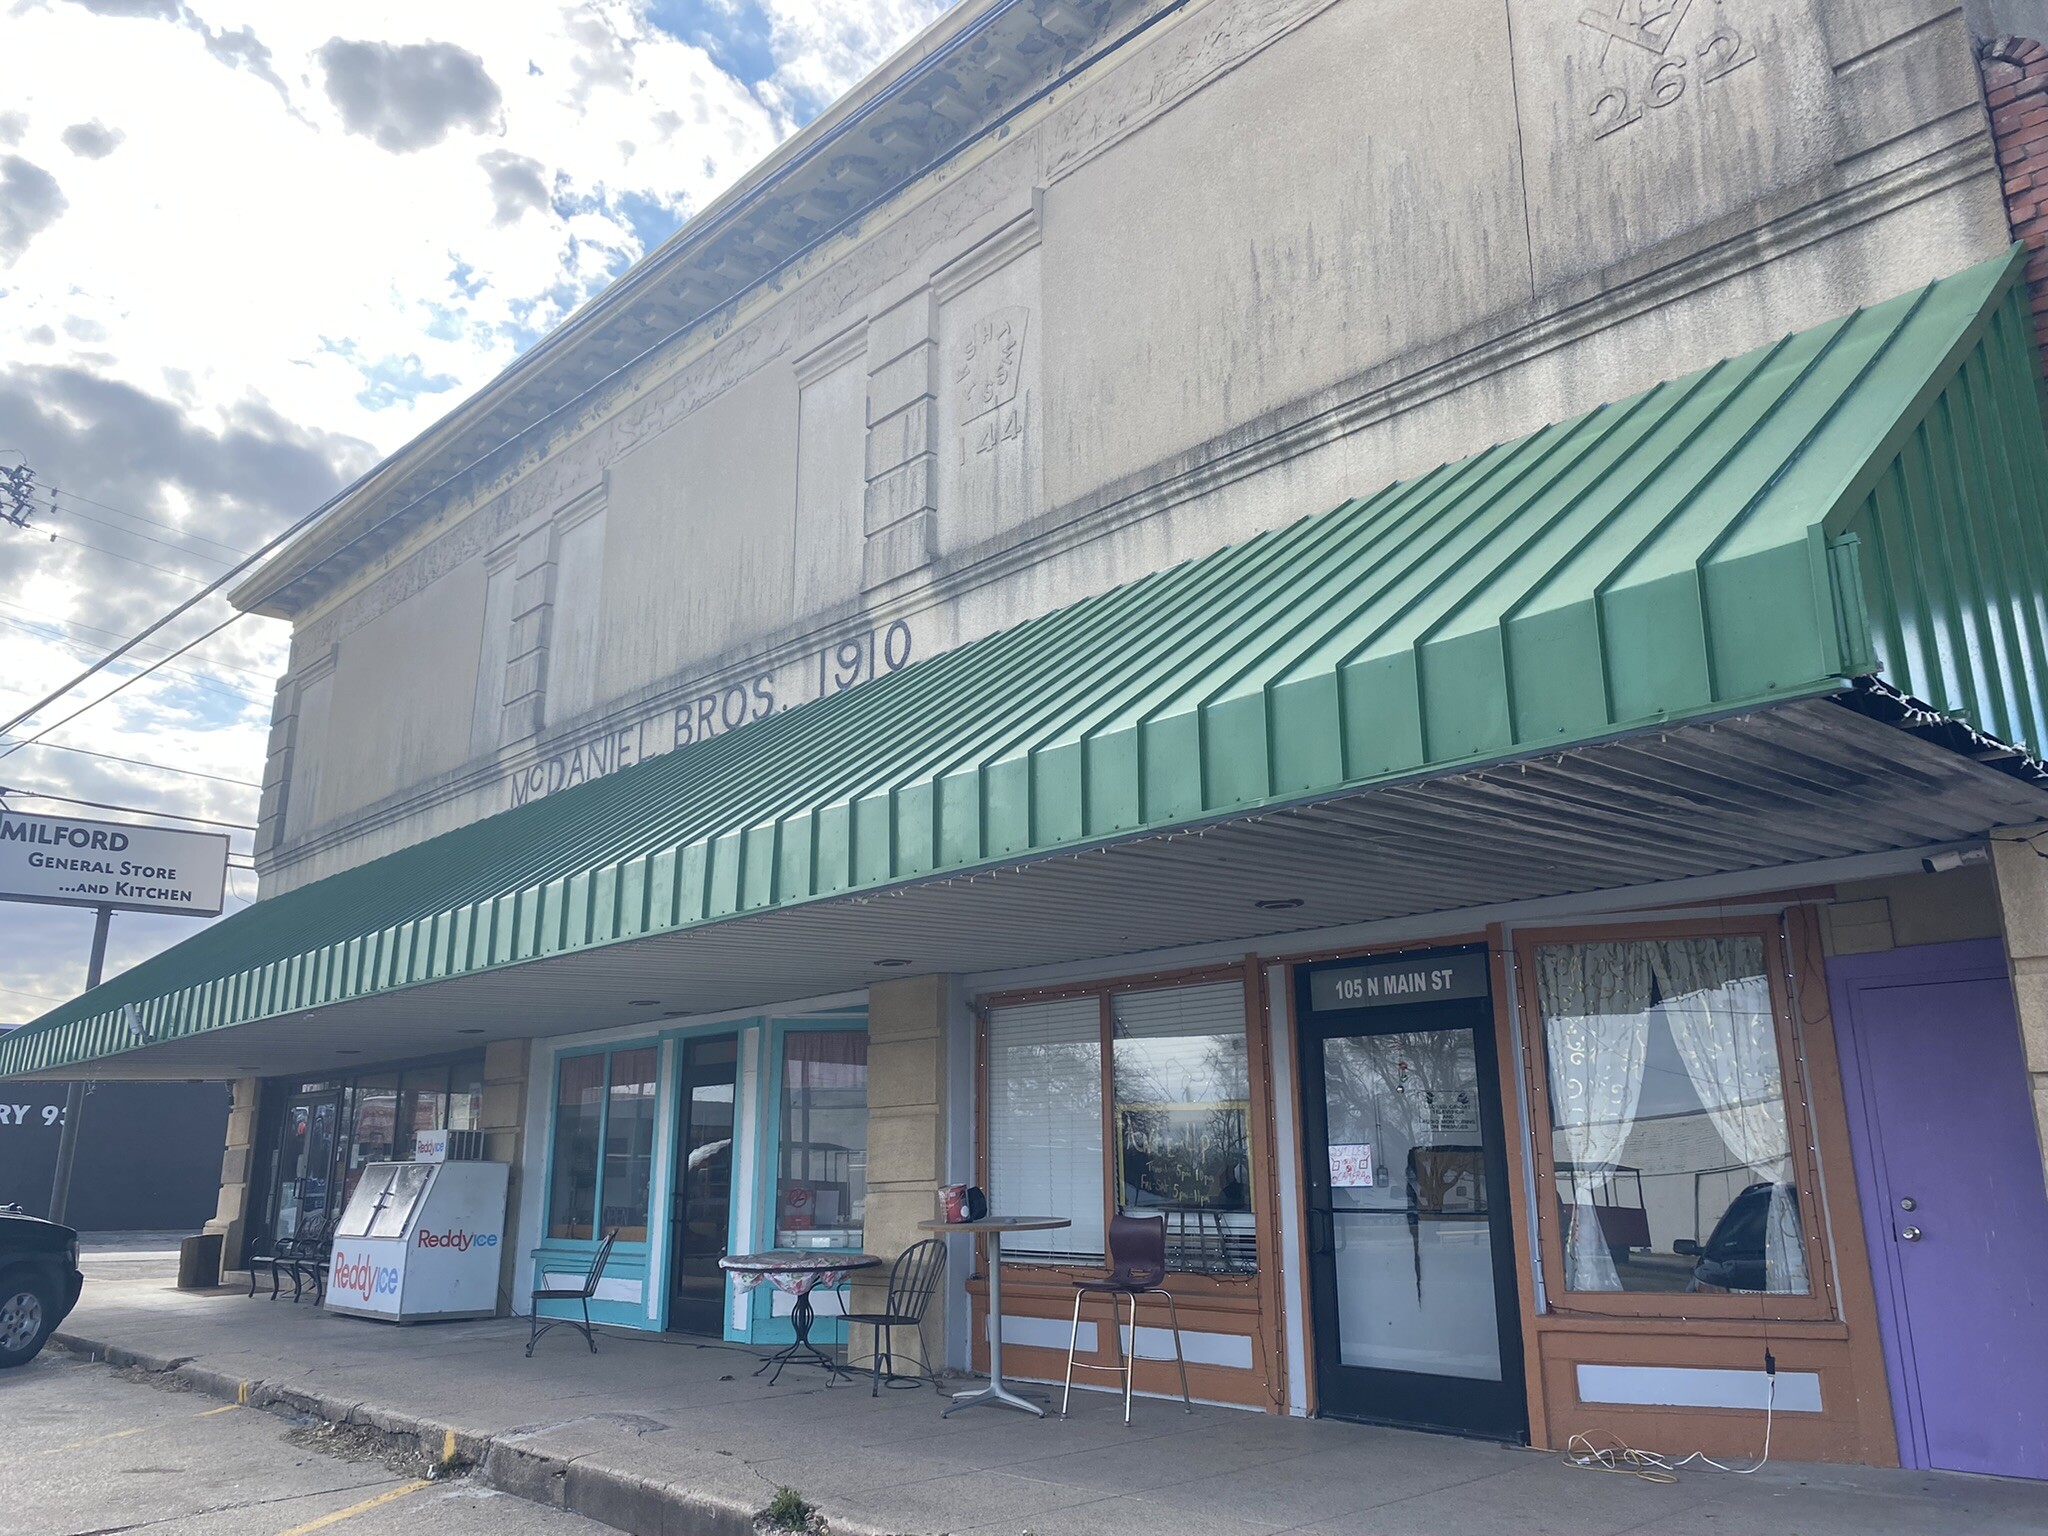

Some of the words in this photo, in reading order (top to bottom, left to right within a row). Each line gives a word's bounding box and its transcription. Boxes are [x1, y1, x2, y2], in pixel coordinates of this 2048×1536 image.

[1588, 27, 1757, 141] 262
[960, 409, 1023, 467] 144
[819, 619, 912, 698] 1910
[0, 820, 129, 851] MILFORD
[28, 852, 114, 875] GENERAL
[119, 860, 177, 880] STORE
[115, 881, 192, 902] KITCHEN
[1335, 978, 1363, 1000] 105
[1367, 977, 1379, 997] N
[1383, 972, 1426, 995] MAIN
[1431, 968, 1453, 991] ST
